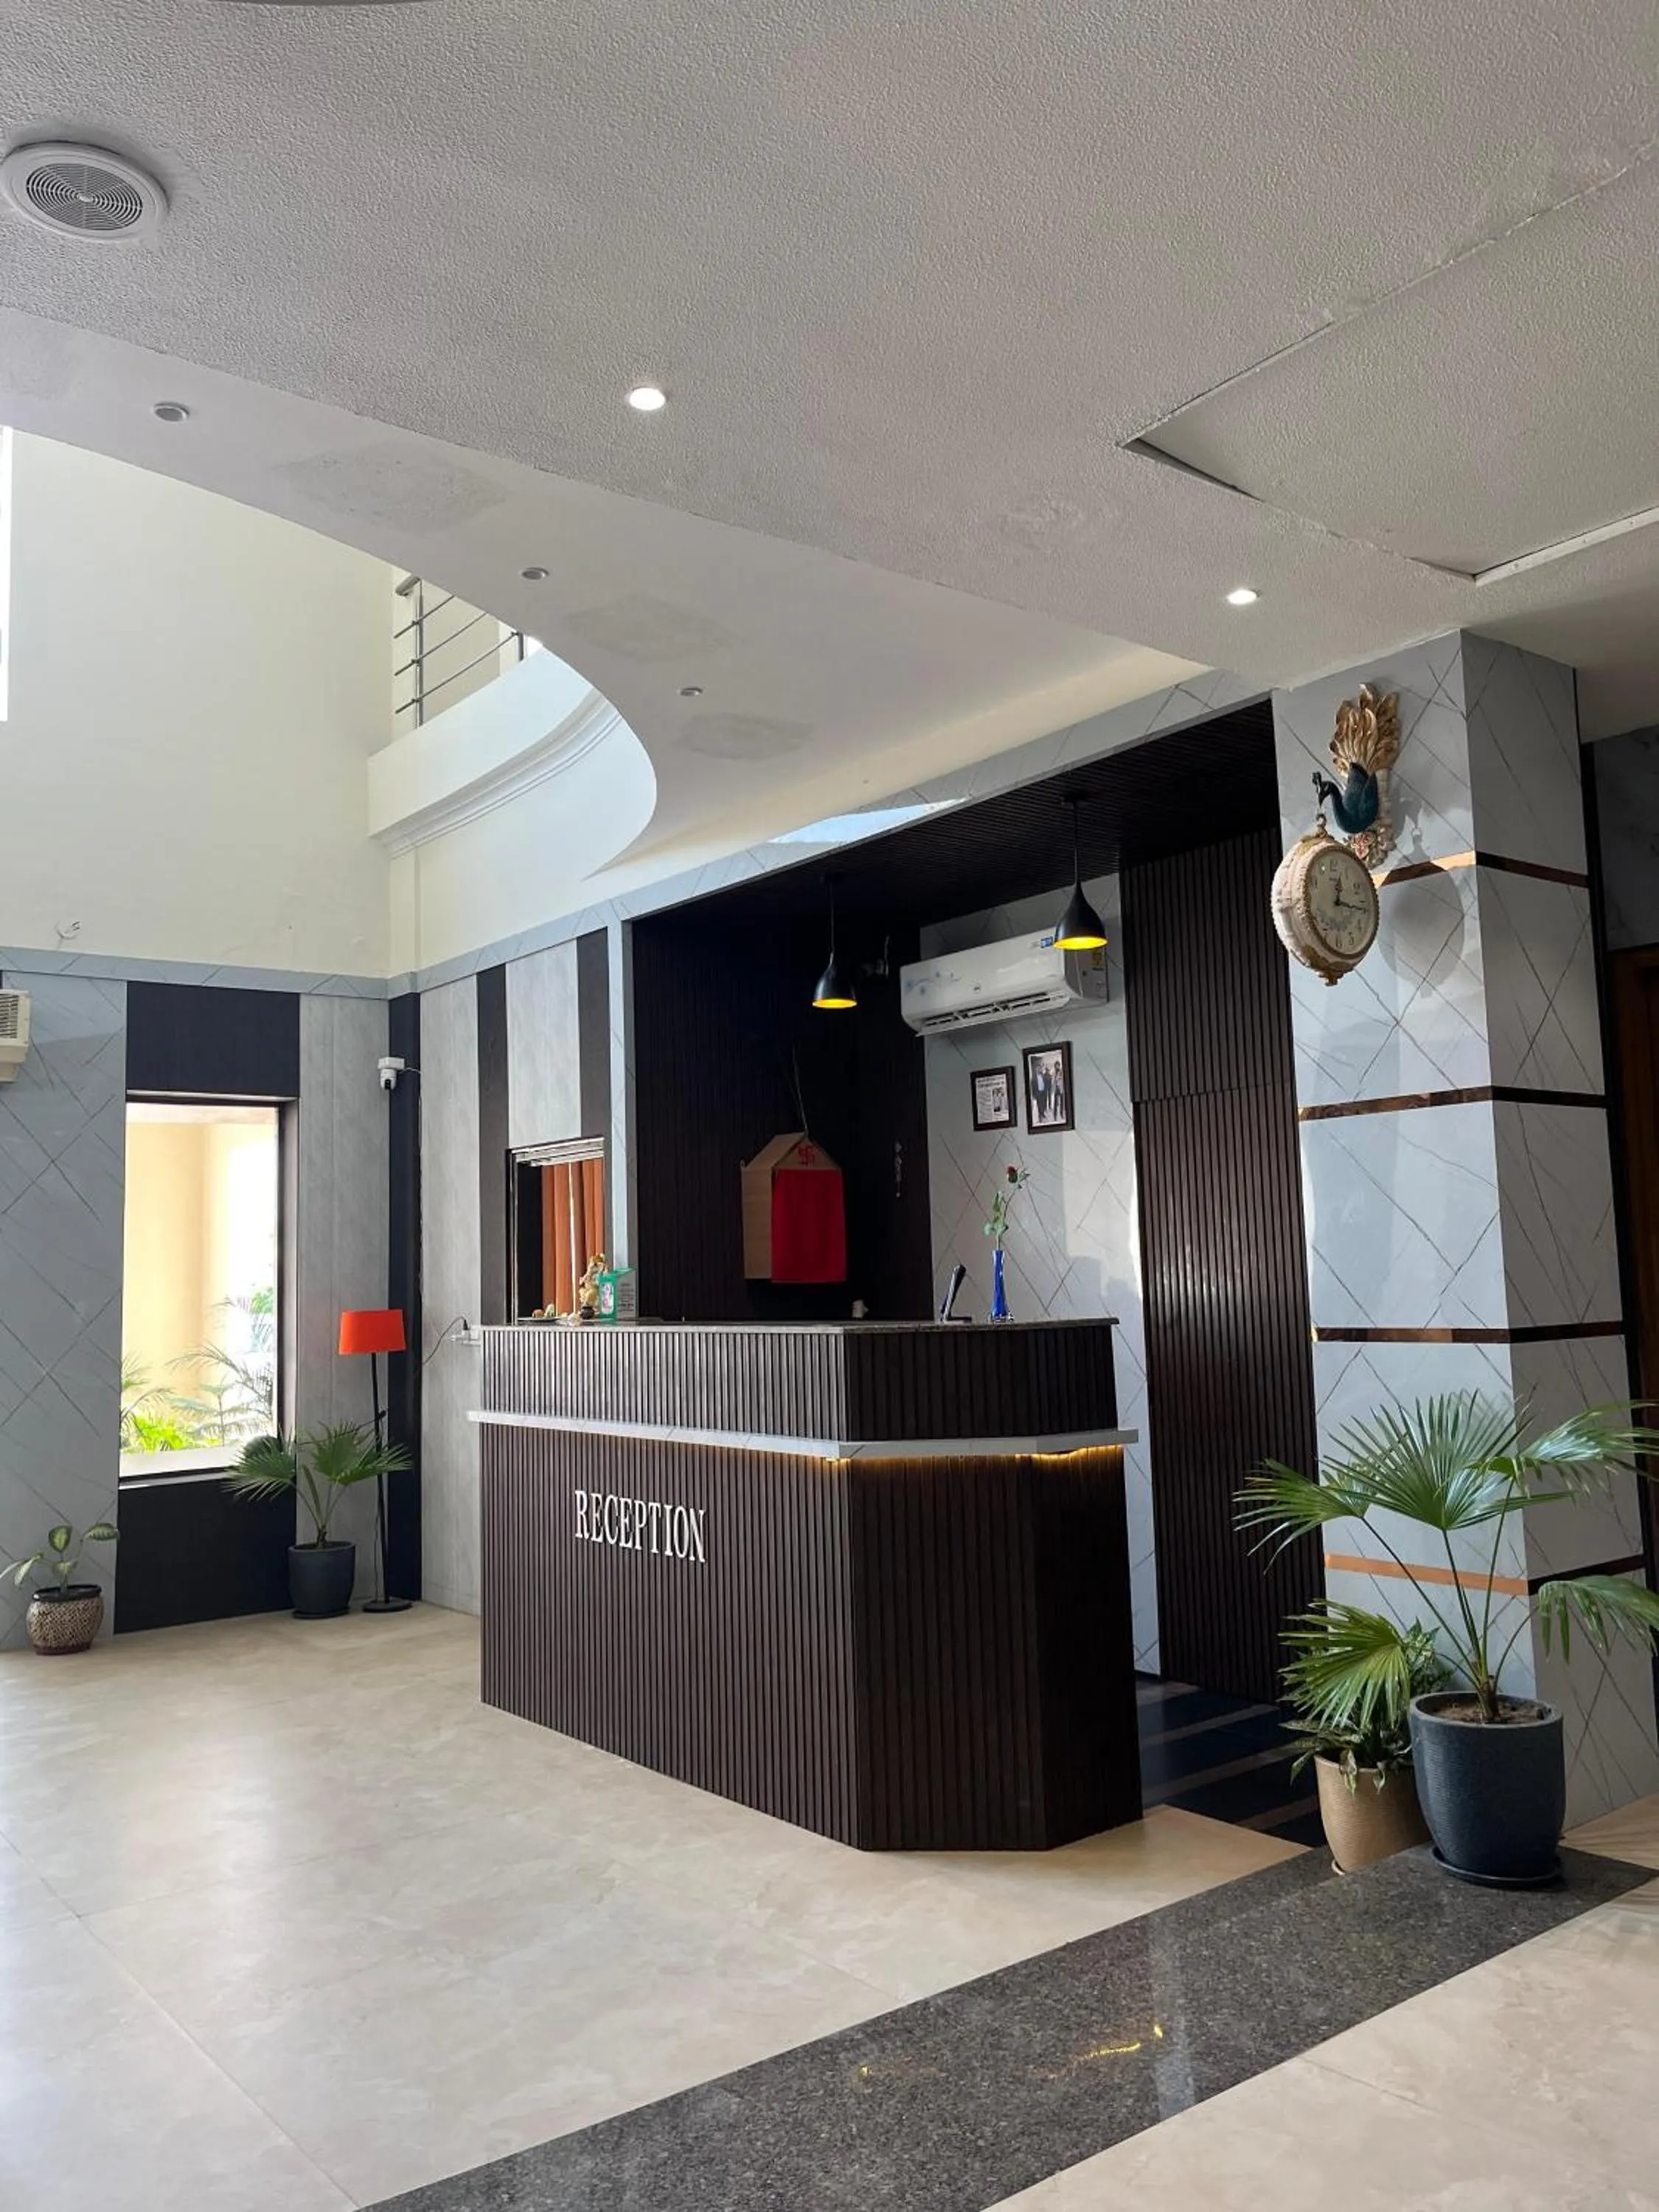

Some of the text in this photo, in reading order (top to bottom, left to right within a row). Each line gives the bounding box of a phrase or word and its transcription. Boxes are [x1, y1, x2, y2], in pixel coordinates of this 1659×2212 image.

[1330, 860, 1338, 872] 12
[1335, 935, 1343, 948] 6
[574, 1489, 706, 1563] RECEPTION
